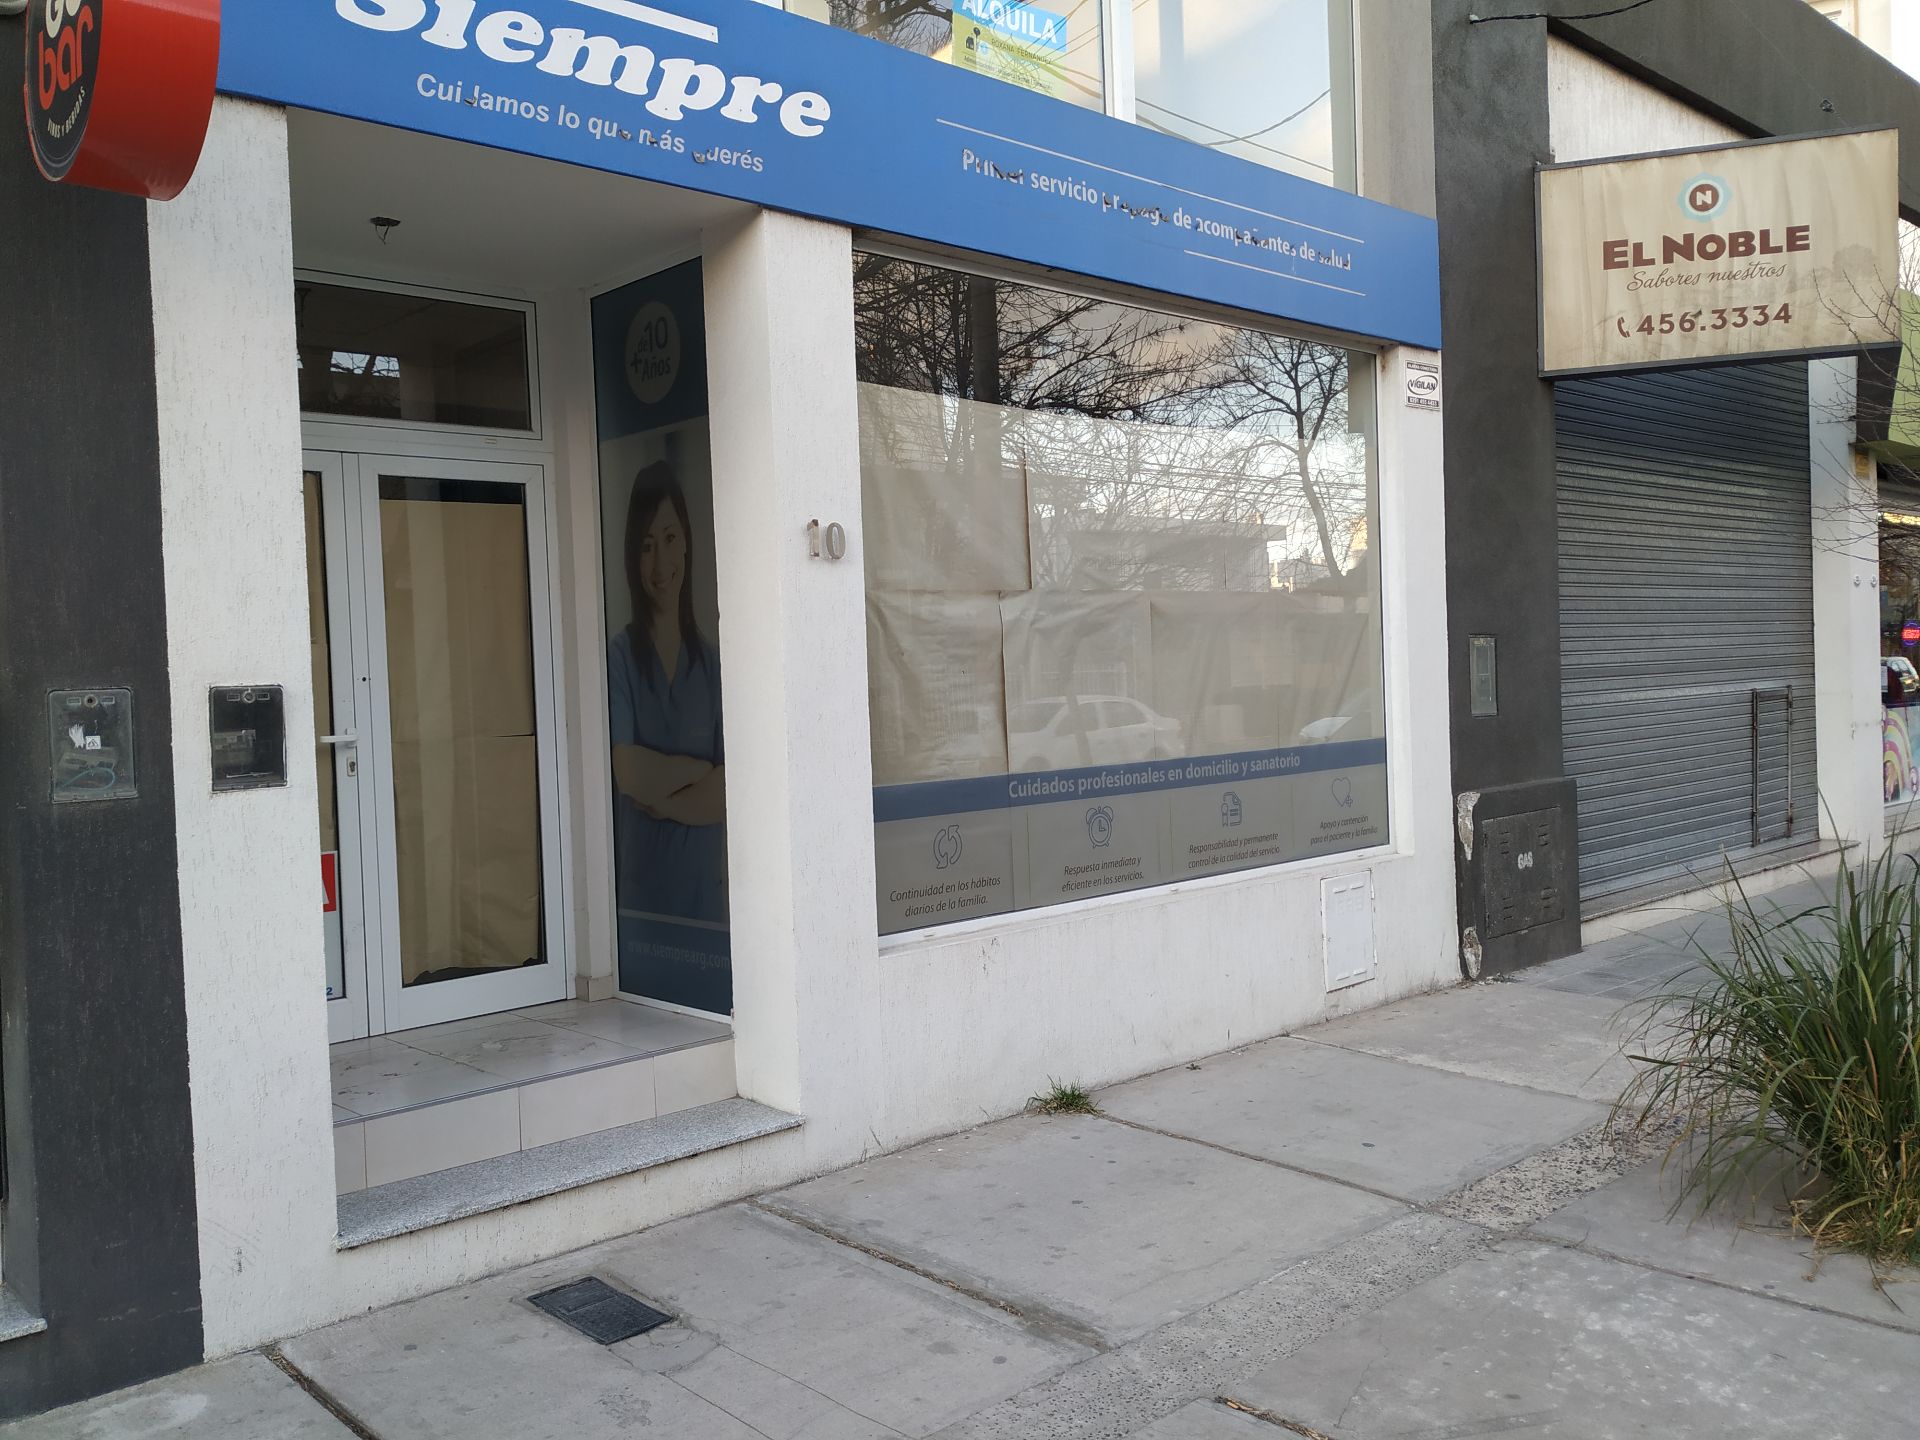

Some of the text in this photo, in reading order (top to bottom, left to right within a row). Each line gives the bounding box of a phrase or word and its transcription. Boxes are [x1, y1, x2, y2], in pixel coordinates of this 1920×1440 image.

[46, 0, 80, 38] G
[962, 0, 1057, 44] ALQUILA
[38, 5, 93, 110] bar
[558, 104, 580, 129] lo
[1696, 190, 1712, 206] N
[1030, 172, 1098, 205] servicio
[1173, 207, 1192, 229] de
[1300, 241, 1316, 261] de
[1603, 225, 1811, 270] EL NOBLE
[1626, 261, 1787, 292] Sabores nuestros
[1636, 302, 1792, 336] 456.3334
[644, 317, 668, 353] 10
[641, 357, 671, 383] Años
[806, 518, 846, 560] 10
[1008, 753, 1300, 798] Cuidados profesionales en domicilio y sanatorio
[1188, 856, 1211, 869] control
[1211, 854, 1218, 864] de
[1226, 849, 1249, 861] calidad
[1249, 847, 1258, 858] del
[1189, 837, 1239, 855] Responsabilidad
[1063, 863, 1100, 877] Respuesta
[1101, 857, 1137, 870] inmediata
[1517, 851, 1534, 870] GAS
[889, 876, 1001, 902] Continuidad en los hábitos
[1061, 879, 1092, 893] eficiente
[1093, 878, 1102, 887] en
[1103, 875, 1113, 885] los
[904, 905, 934, 917] diarios
[936, 899, 946, 911] de
[948, 897, 956, 910] la
